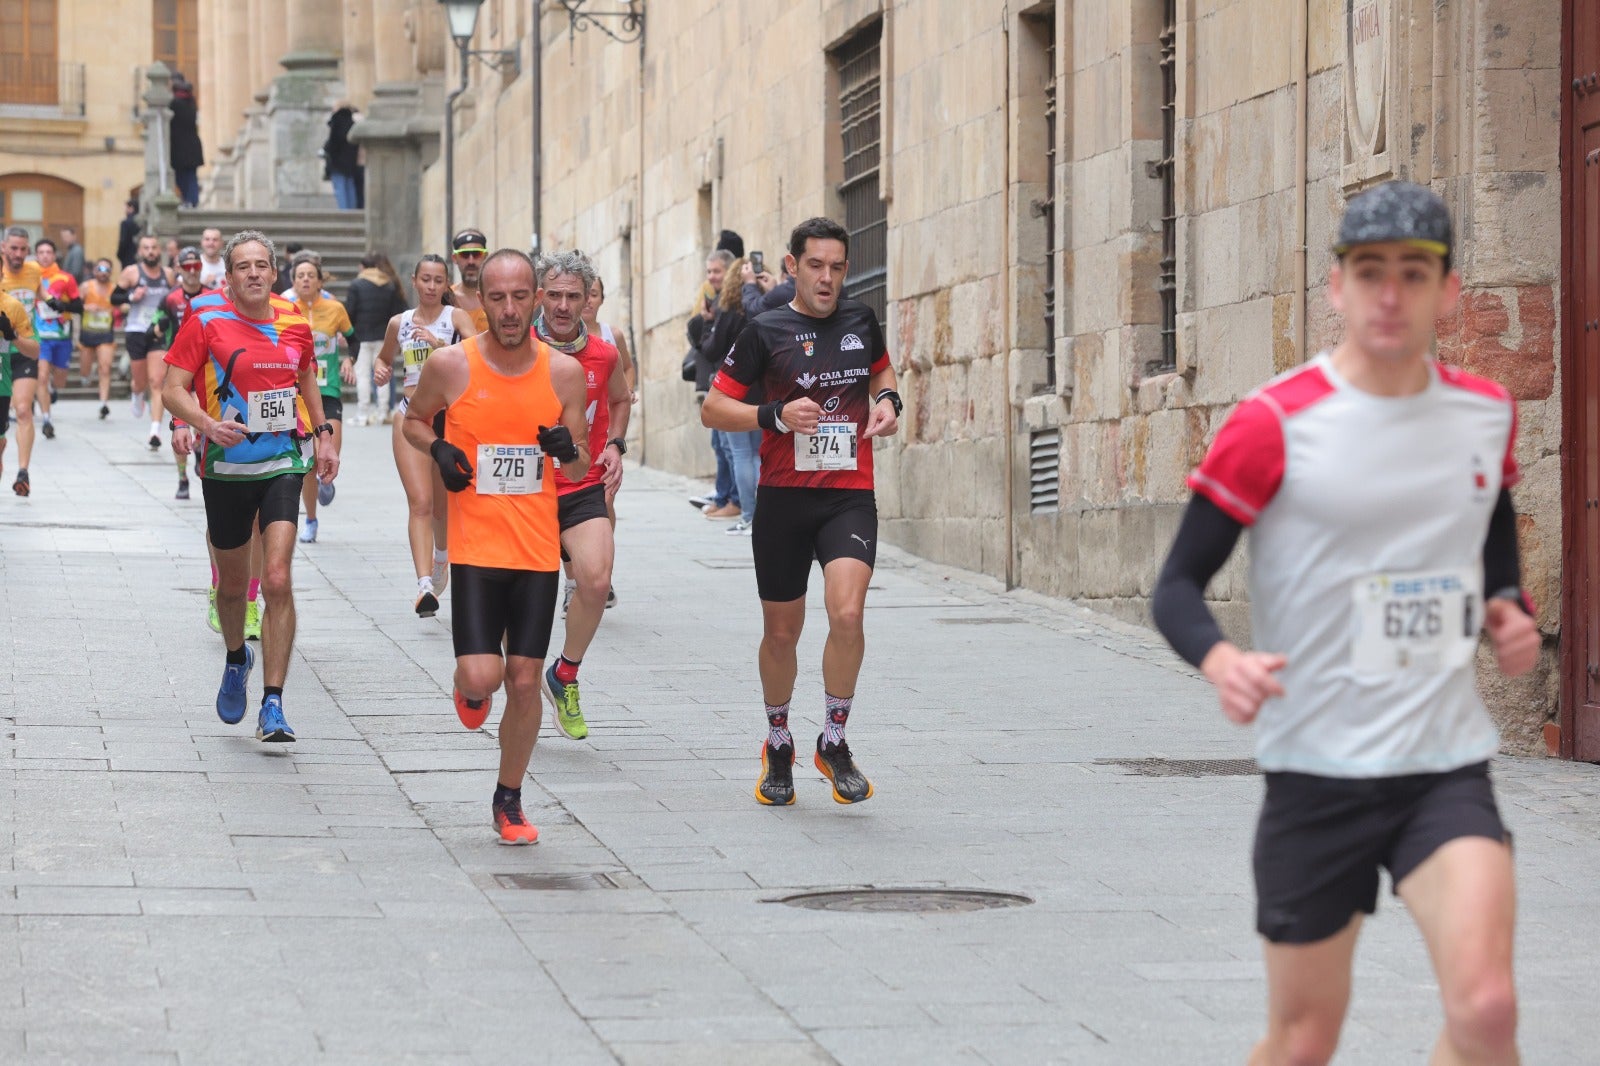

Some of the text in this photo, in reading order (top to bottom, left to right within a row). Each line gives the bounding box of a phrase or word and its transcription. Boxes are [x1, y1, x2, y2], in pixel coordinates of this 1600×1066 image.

[413, 348, 428, 362] 107
[819, 368, 869, 381] CAJA RURAL
[830, 378, 858, 386] ZAMORA
[263, 390, 294, 400] SETEL
[261, 400, 286, 419] 654
[816, 425, 852, 433] SETEL
[496, 447, 540, 456] SETEL
[809, 436, 840, 455] 374
[492, 458, 524, 477] 276
[1393, 577, 1462, 594] SETEL
[1384, 598, 1442, 639] 626
